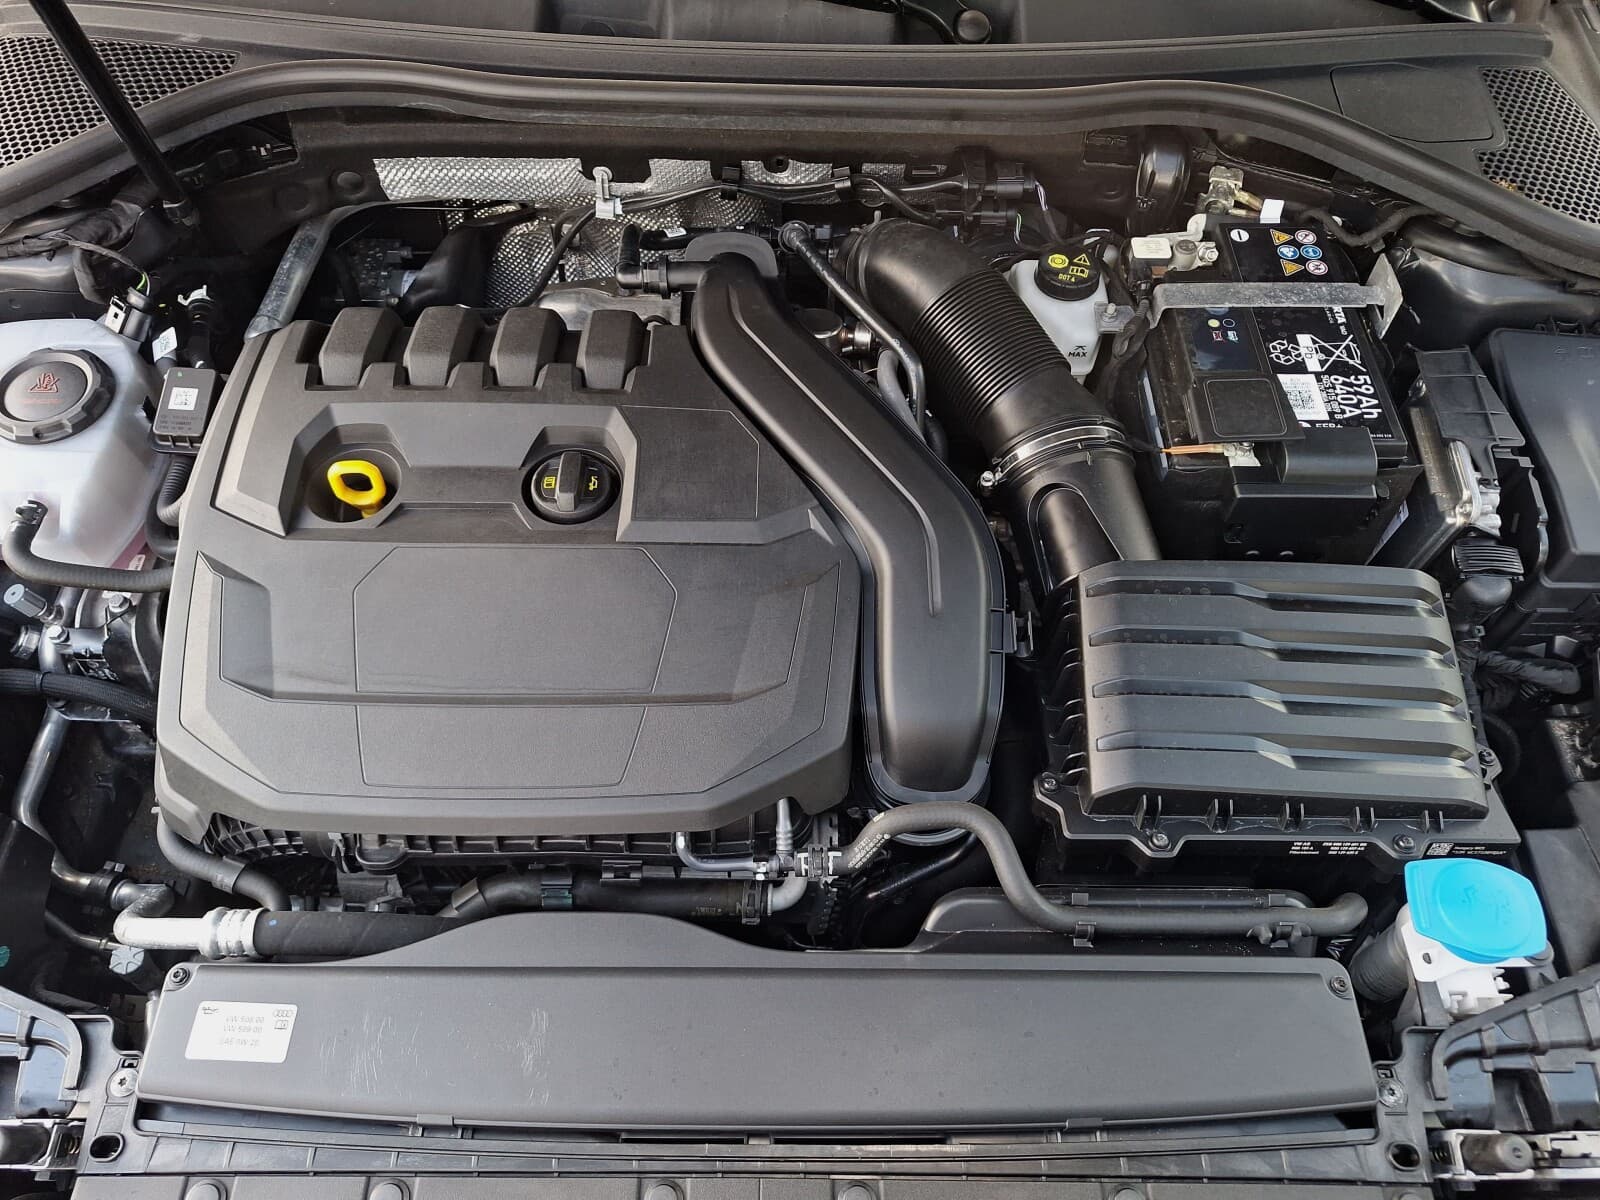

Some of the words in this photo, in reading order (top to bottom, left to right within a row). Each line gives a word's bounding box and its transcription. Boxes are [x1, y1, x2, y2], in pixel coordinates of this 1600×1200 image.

[1332, 306, 1347, 324] RTA
[1302, 346, 1314, 360] Pb
[1330, 375, 1362, 418] 640A
[1350, 375, 1382, 419] 59Ah
